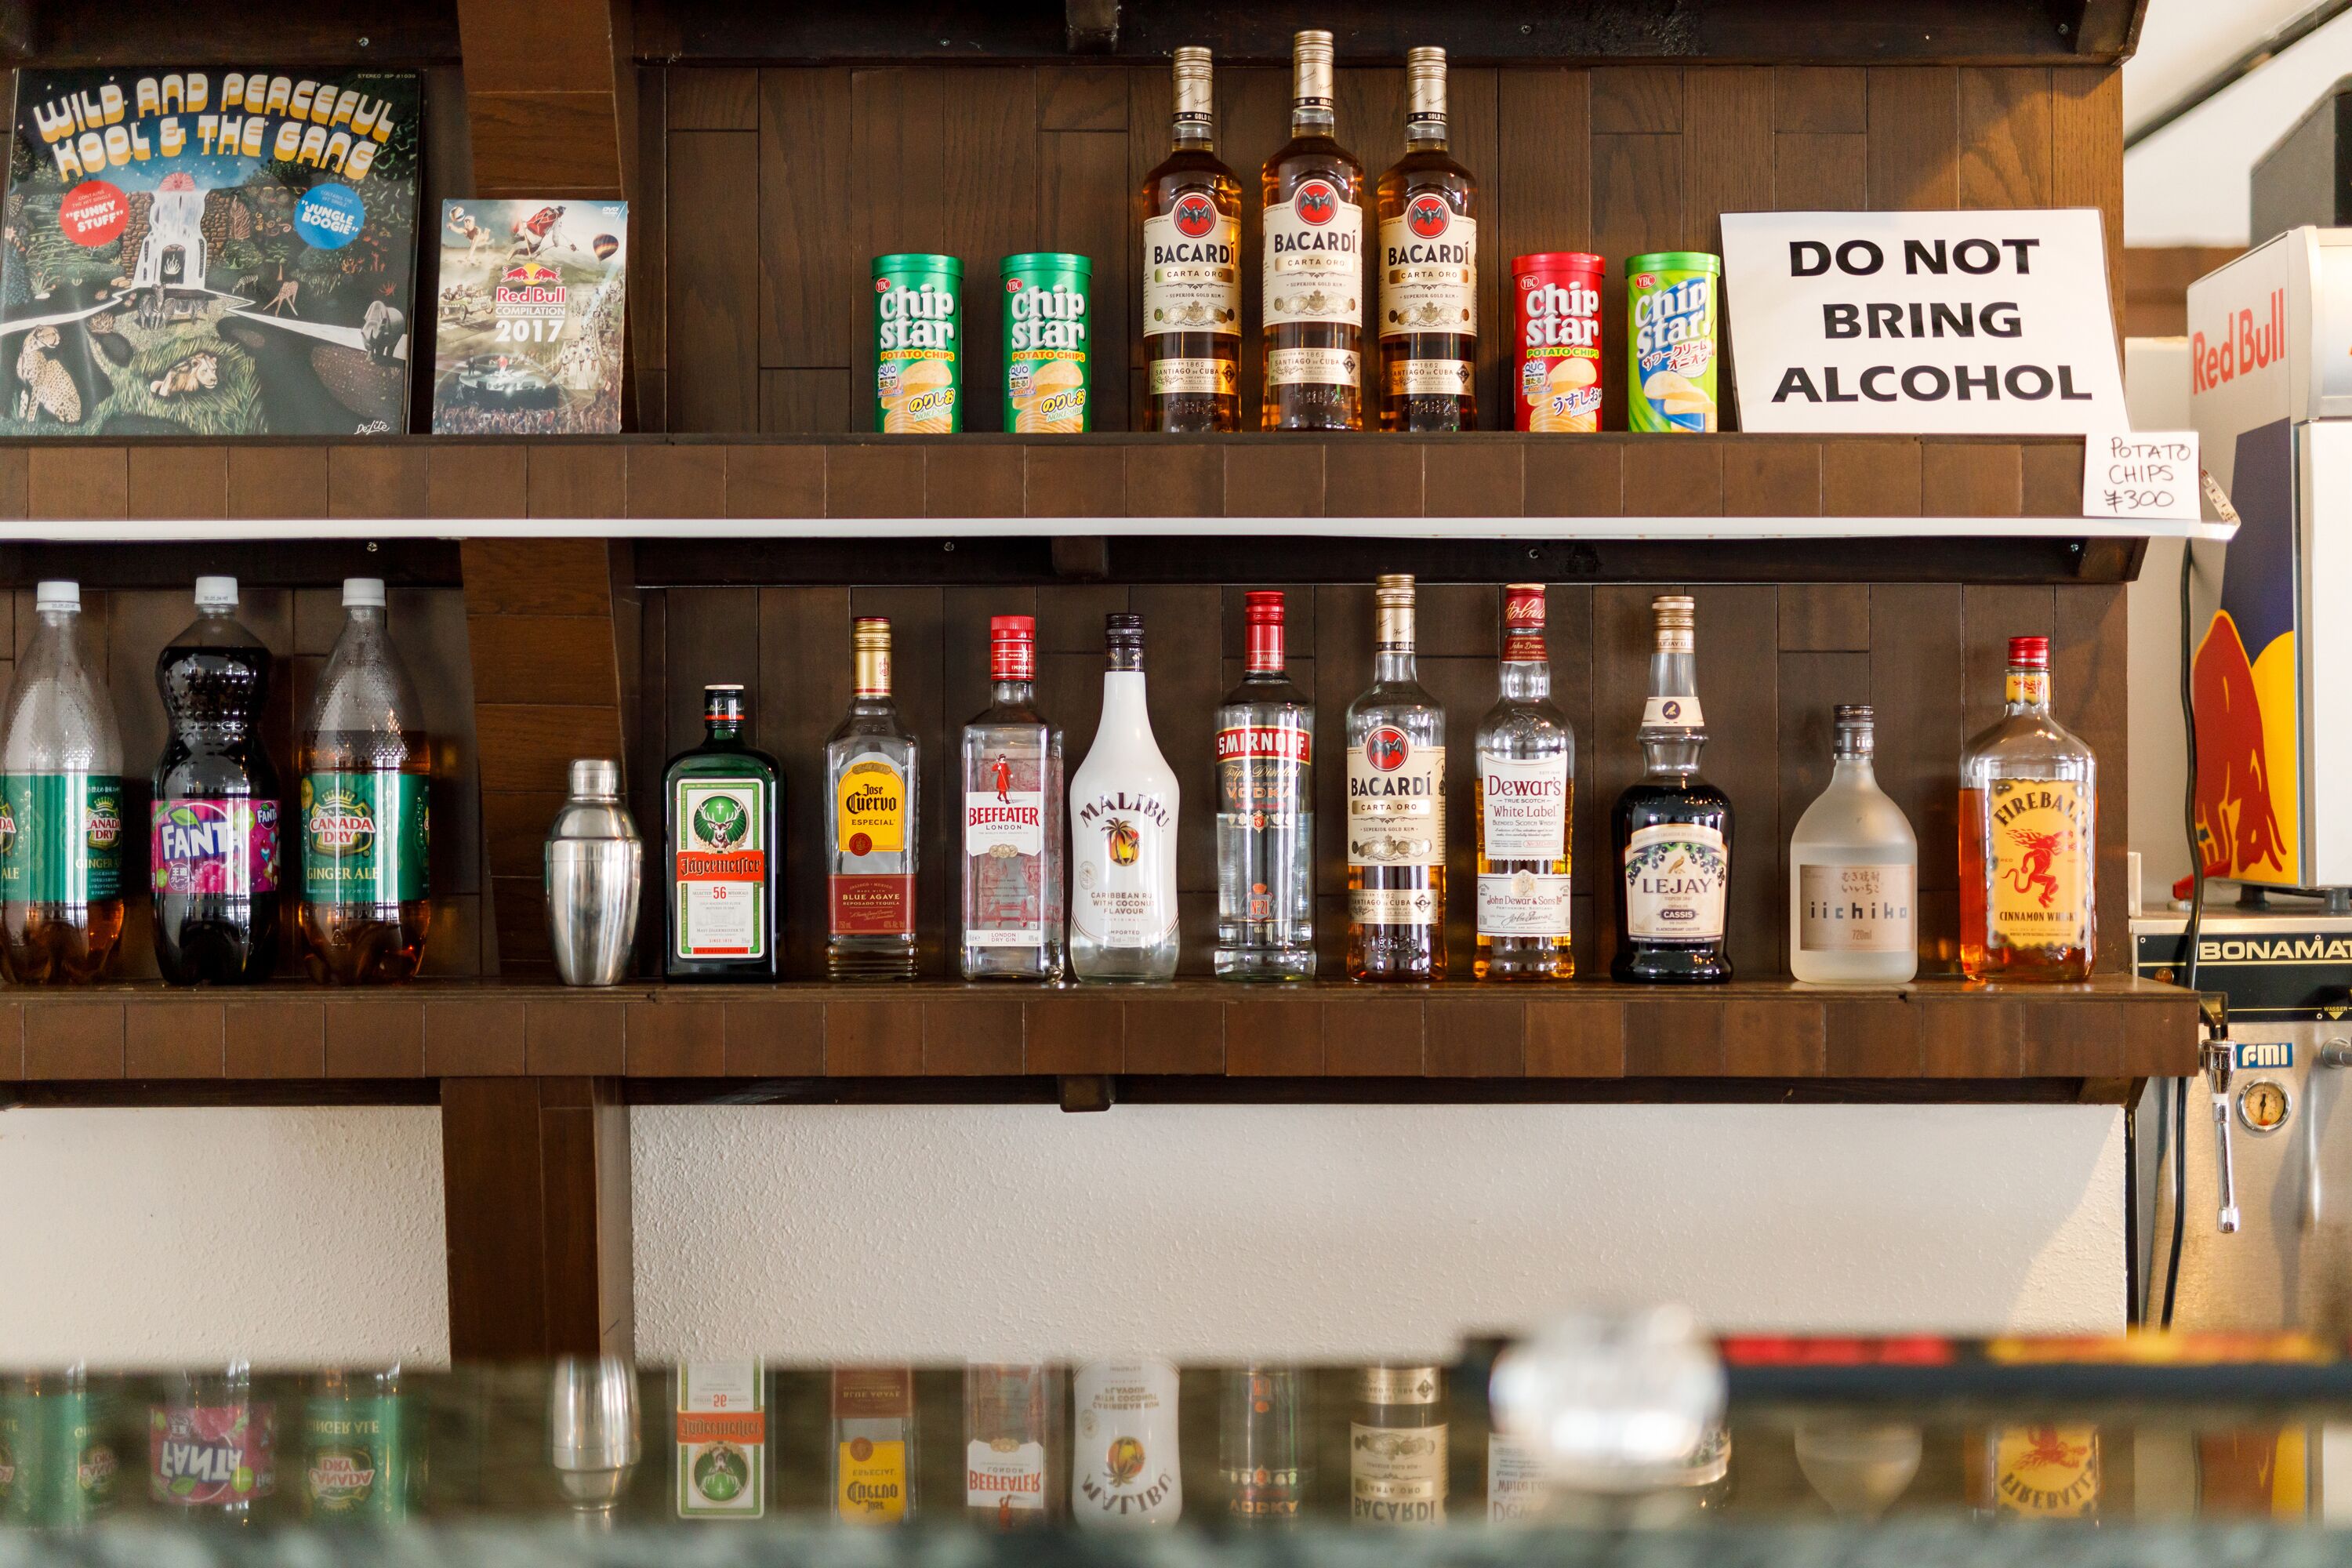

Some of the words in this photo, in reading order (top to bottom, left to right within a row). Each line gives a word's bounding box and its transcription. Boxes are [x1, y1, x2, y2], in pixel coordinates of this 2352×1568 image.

[33, 84, 125, 143] WILD
[136, 73, 209, 118] AND
[220, 72, 394, 144] PEACEFUL
[52, 122, 150, 182] KOOL
[160, 117, 187, 157] &
[198, 114, 268, 157] THE
[274, 121, 379, 180] GANG
[65, 200, 115, 222] "FUNKY
[77, 209, 124, 233] STUFF"
[301, 200, 355, 226] "JUNGLE
[301, 212, 359, 234] BOOGIE"
[1274, 229, 1356, 253] BACARDÍ
[1155, 241, 1235, 265] BACARDÍ
[1388, 241, 1469, 266] BACARDÍ
[1789, 239, 1884, 277] DO
[1903, 238, 2040, 275] NOT
[877, 280, 888, 291] YBC
[1008, 280, 1022, 291] YBC
[1523, 277, 1537, 288] YBC
[1638, 274, 1654, 288] YBC
[497, 287, 531, 303] Red
[533, 287, 565, 303] Bull
[880, 283, 955, 321] chip
[1011, 284, 1086, 321] chip
[1526, 281, 1599, 318] chip
[495, 307, 565, 315] COMPILATION
[1822, 301, 2023, 339] BRING
[495, 319, 565, 343] 2017
[880, 315, 955, 350] star
[1011, 316, 1086, 351] star
[1526, 314, 1599, 347] star
[2192, 312, 2234, 395] Red
[2238, 288, 2285, 376] Bull
[881, 350, 922, 361] POTATO
[924, 350, 955, 361] CHIPS
[1013, 350, 1054, 361] POTATO
[1056, 350, 1086, 362] CHIPS
[1527, 348, 1570, 358] POTATO
[1573, 348, 1599, 359] CHIPS
[1642, 342, 1708, 371] サワークリーム
[1668, 353, 1708, 371] オニオン
[879, 365, 896, 376] QUO
[1011, 365, 1029, 376] QUO
[1155, 368, 1191, 376] SANTIAGO
[1525, 362, 1544, 373] QUO
[1770, 364, 2092, 403] ALCOHOL
[909, 388, 955, 412] のりしお
[1041, 390, 1085, 413] のりしお
[2111, 437, 2190, 461] POTATO
[2109, 464, 2174, 485] CHIPS
[2104, 489, 2174, 514] ¥300
[862, 783, 884, 797] Jose
[1351, 771, 1432, 797] BACARDÍ
[1488, 775, 1562, 797] Dewar's
[846, 791, 897, 815] Cuervo
[1079, 792, 1171, 828] MALIBU
[1993, 791, 2085, 826] FIREBALL
[310, 817, 374, 832] CANADA
[969, 807, 1040, 827] BEEFEATER
[95, 829, 114, 840] DRY
[324, 831, 353, 844] DRY
[307, 867, 352, 880] GINGER
[681, 857, 761, 877] Jägermeister
[713, 886, 727, 899] 56
[1642, 878, 1711, 894] LEJAY
[1486, 895, 1503, 906] John
[1504, 895, 1531, 905] Dewar
[1538, 895, 1556, 905] Sons
[1811, 902, 1907, 919] iichiko
[1999, 912, 2045, 922] CINNAMON
[1852, 930, 1872, 940] 720ml
